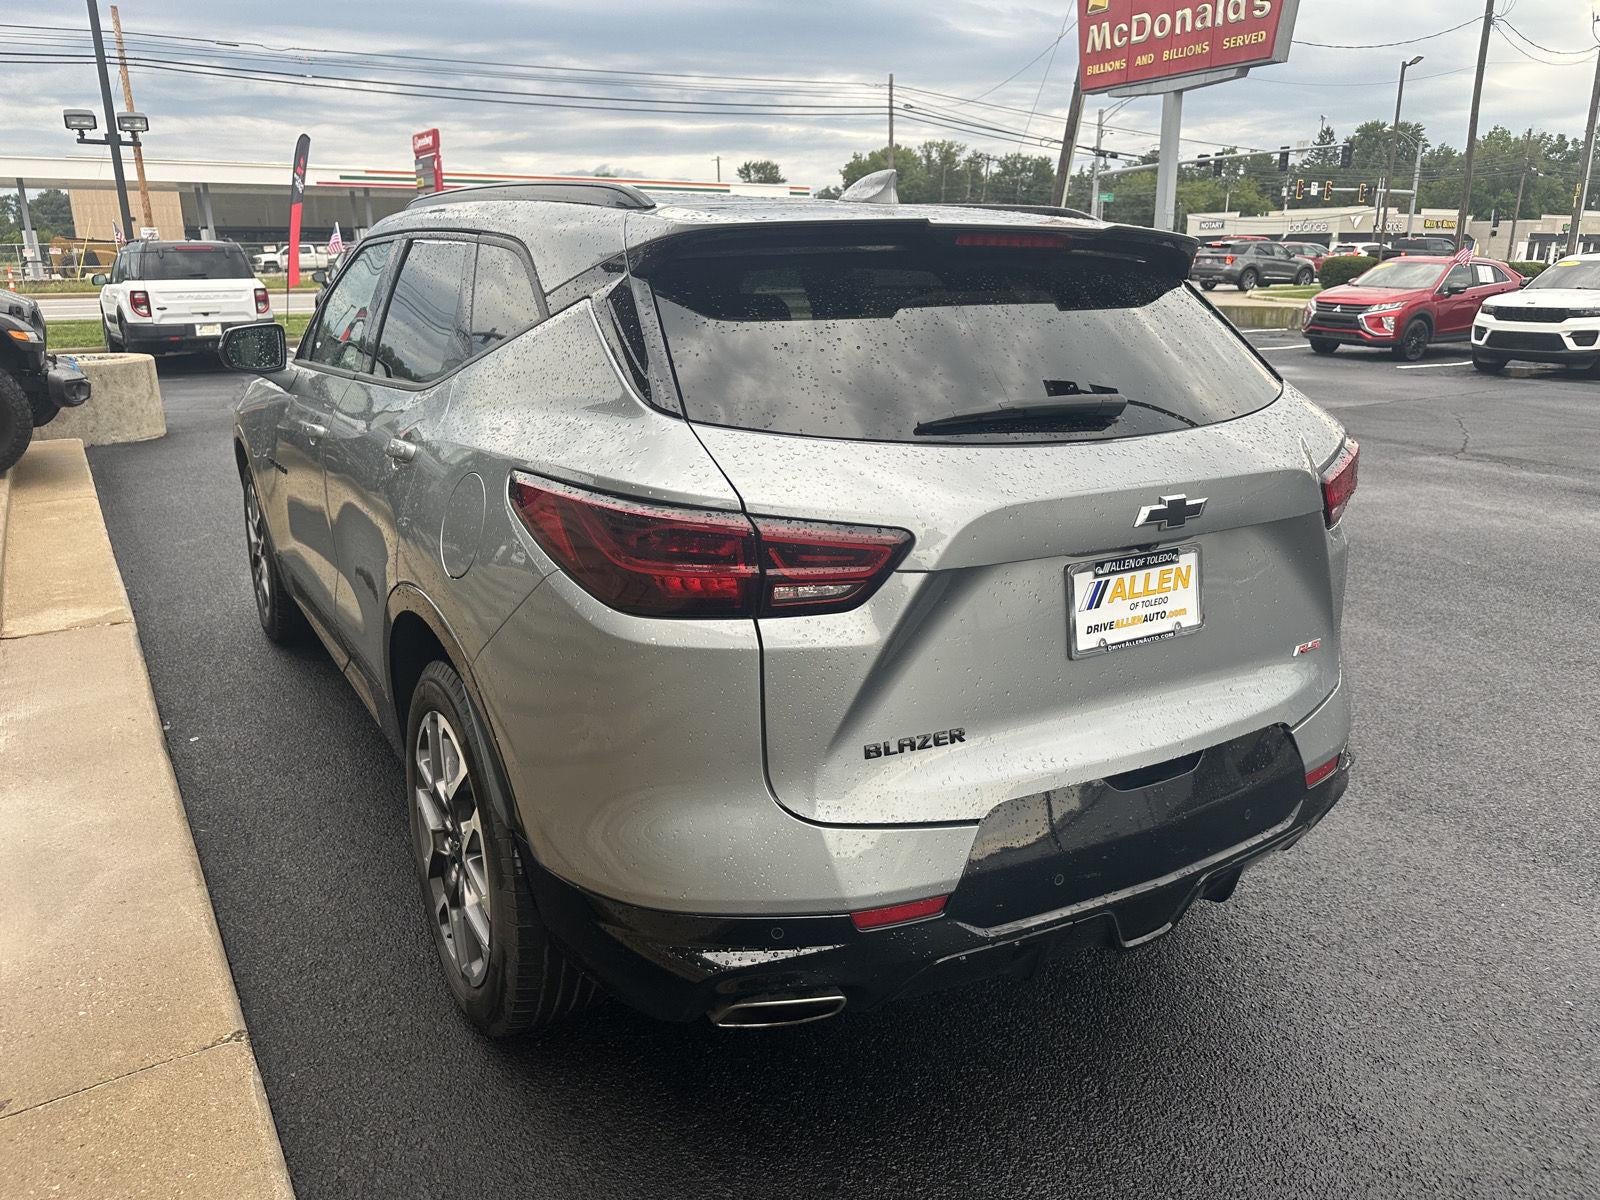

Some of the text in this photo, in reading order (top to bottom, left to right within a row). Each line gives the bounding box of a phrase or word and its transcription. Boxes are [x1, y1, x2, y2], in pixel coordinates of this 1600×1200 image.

[1086, 0, 1271, 55] McDonalds
[1087, 30, 1267, 76] BILLIONS AND BILLIONS SERVED
[1201, 221, 1224, 230] NOTARY
[1109, 552, 1173, 572] ALLEN OF TOLEDO
[1108, 565, 1192, 604] ALLEN
[1129, 596, 1169, 611] OF TOLEDO
[863, 727, 967, 760] BLAZER
